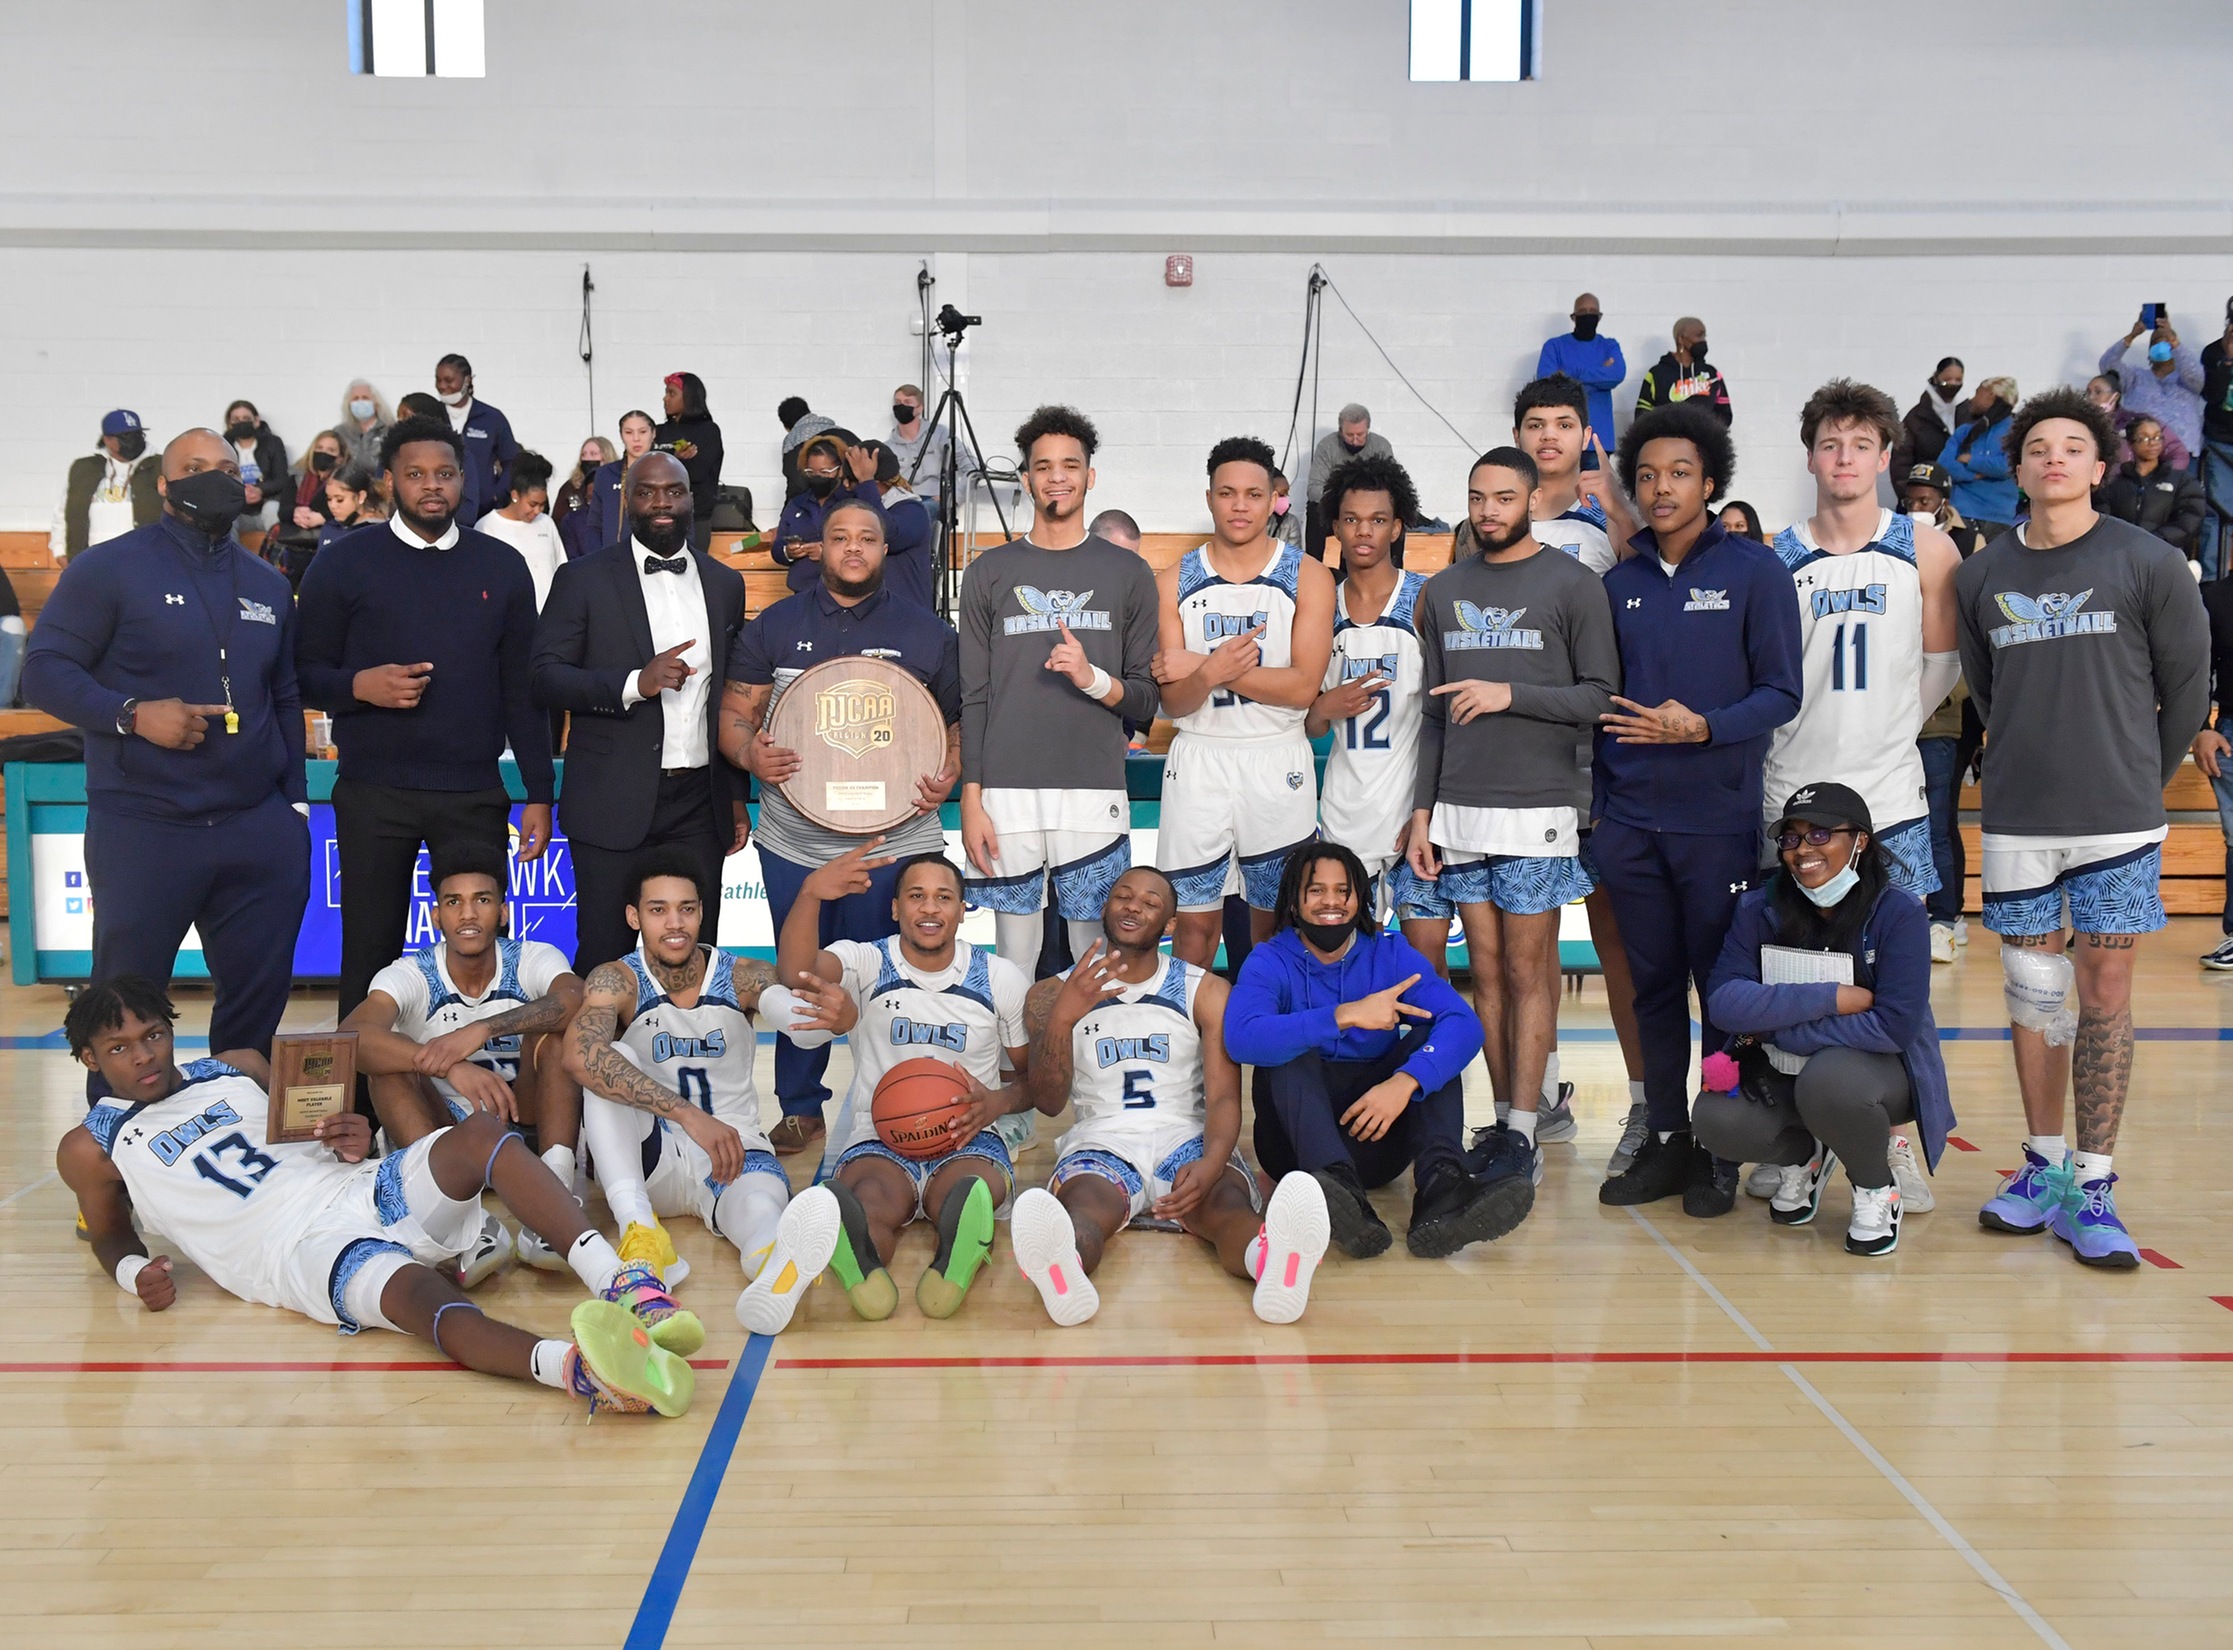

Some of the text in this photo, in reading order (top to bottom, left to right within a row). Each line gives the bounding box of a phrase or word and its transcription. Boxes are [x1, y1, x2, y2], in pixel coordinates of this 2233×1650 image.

[1811, 583, 1887, 621] OWLS
[1003, 610, 1112, 636] BASKETBALL
[1203, 610, 1268, 641] OWLS
[1832, 622, 1868, 692] 11
[819, 694, 894, 731] NJCAA
[1346, 688, 1391, 750] 12
[833, 730, 891, 742] REGION 20
[720, 881, 768, 899] athle
[652, 1029, 727, 1064] OWLS
[892, 1016, 968, 1053] OWLS
[1095, 1033, 1169, 1069] OWLS
[677, 1066, 714, 1115] 0
[1122, 1070, 1157, 1110] 5
[148, 1099, 243, 1167] OWLS
[890, 1115, 957, 1144] SPALDING
[191, 1130, 283, 1200] 13
